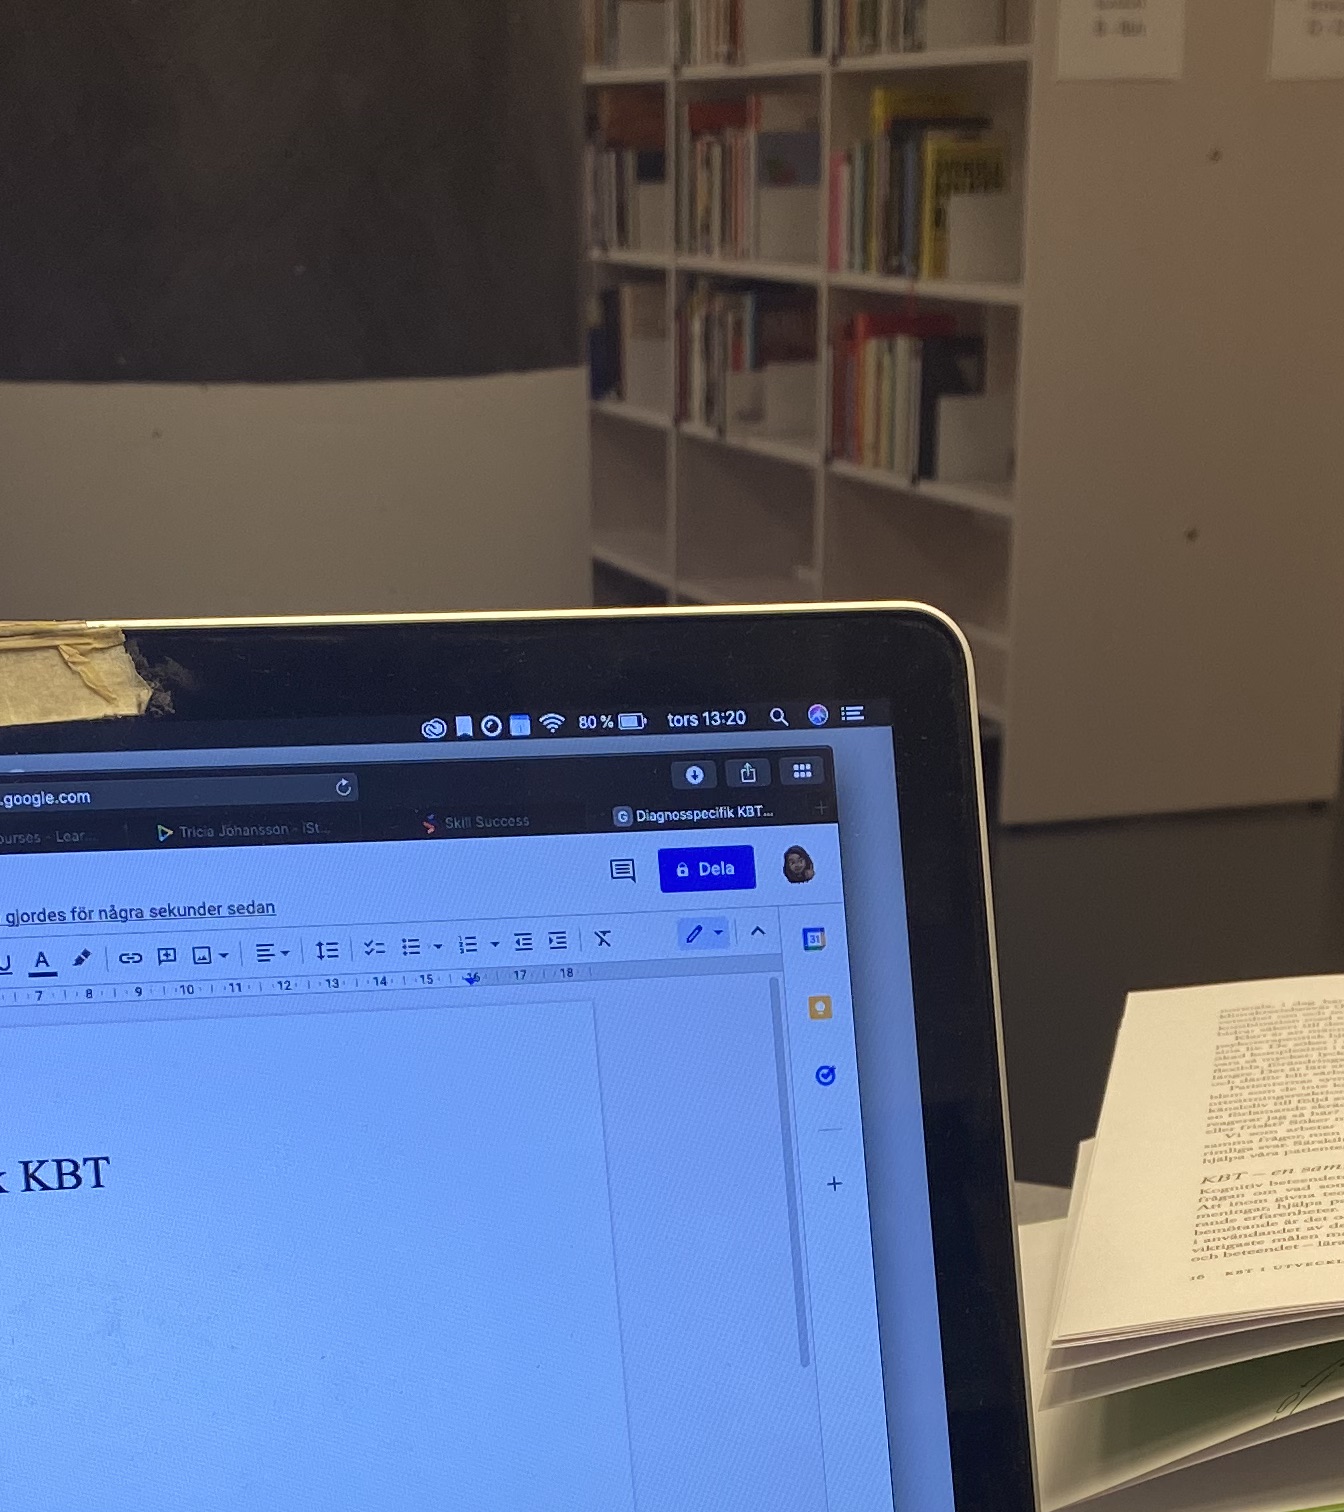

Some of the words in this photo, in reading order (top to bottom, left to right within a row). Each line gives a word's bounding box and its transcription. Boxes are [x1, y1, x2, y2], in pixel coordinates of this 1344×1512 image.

[578, 715, 598, 729] 80
[667, 712, 698, 726] tors
[702, 710, 747, 725] 13:20
[445, 816, 472, 829] Skill
[476, 814, 529, 828] Success
[636, 807, 735, 823] Diagnosspecifik
[179, 825, 213, 838] Tricia
[219, 822, 289, 837] Johansson
[699, 861, 734, 877] Dela
[6, 908, 66, 926] gjordes
[70, 907, 94, 921] för
[98, 905, 144, 921] några
[149, 902, 222, 918] sekunder
[227, 900, 275, 915] sedan
[19, 1157, 110, 1193] KBT
[1200, 1172, 1249, 1185] KBT
[1272, 1168, 1294, 1176] en
[1191, 1253, 1218, 1262] och
[1225, 1268, 1253, 1276] KBT
